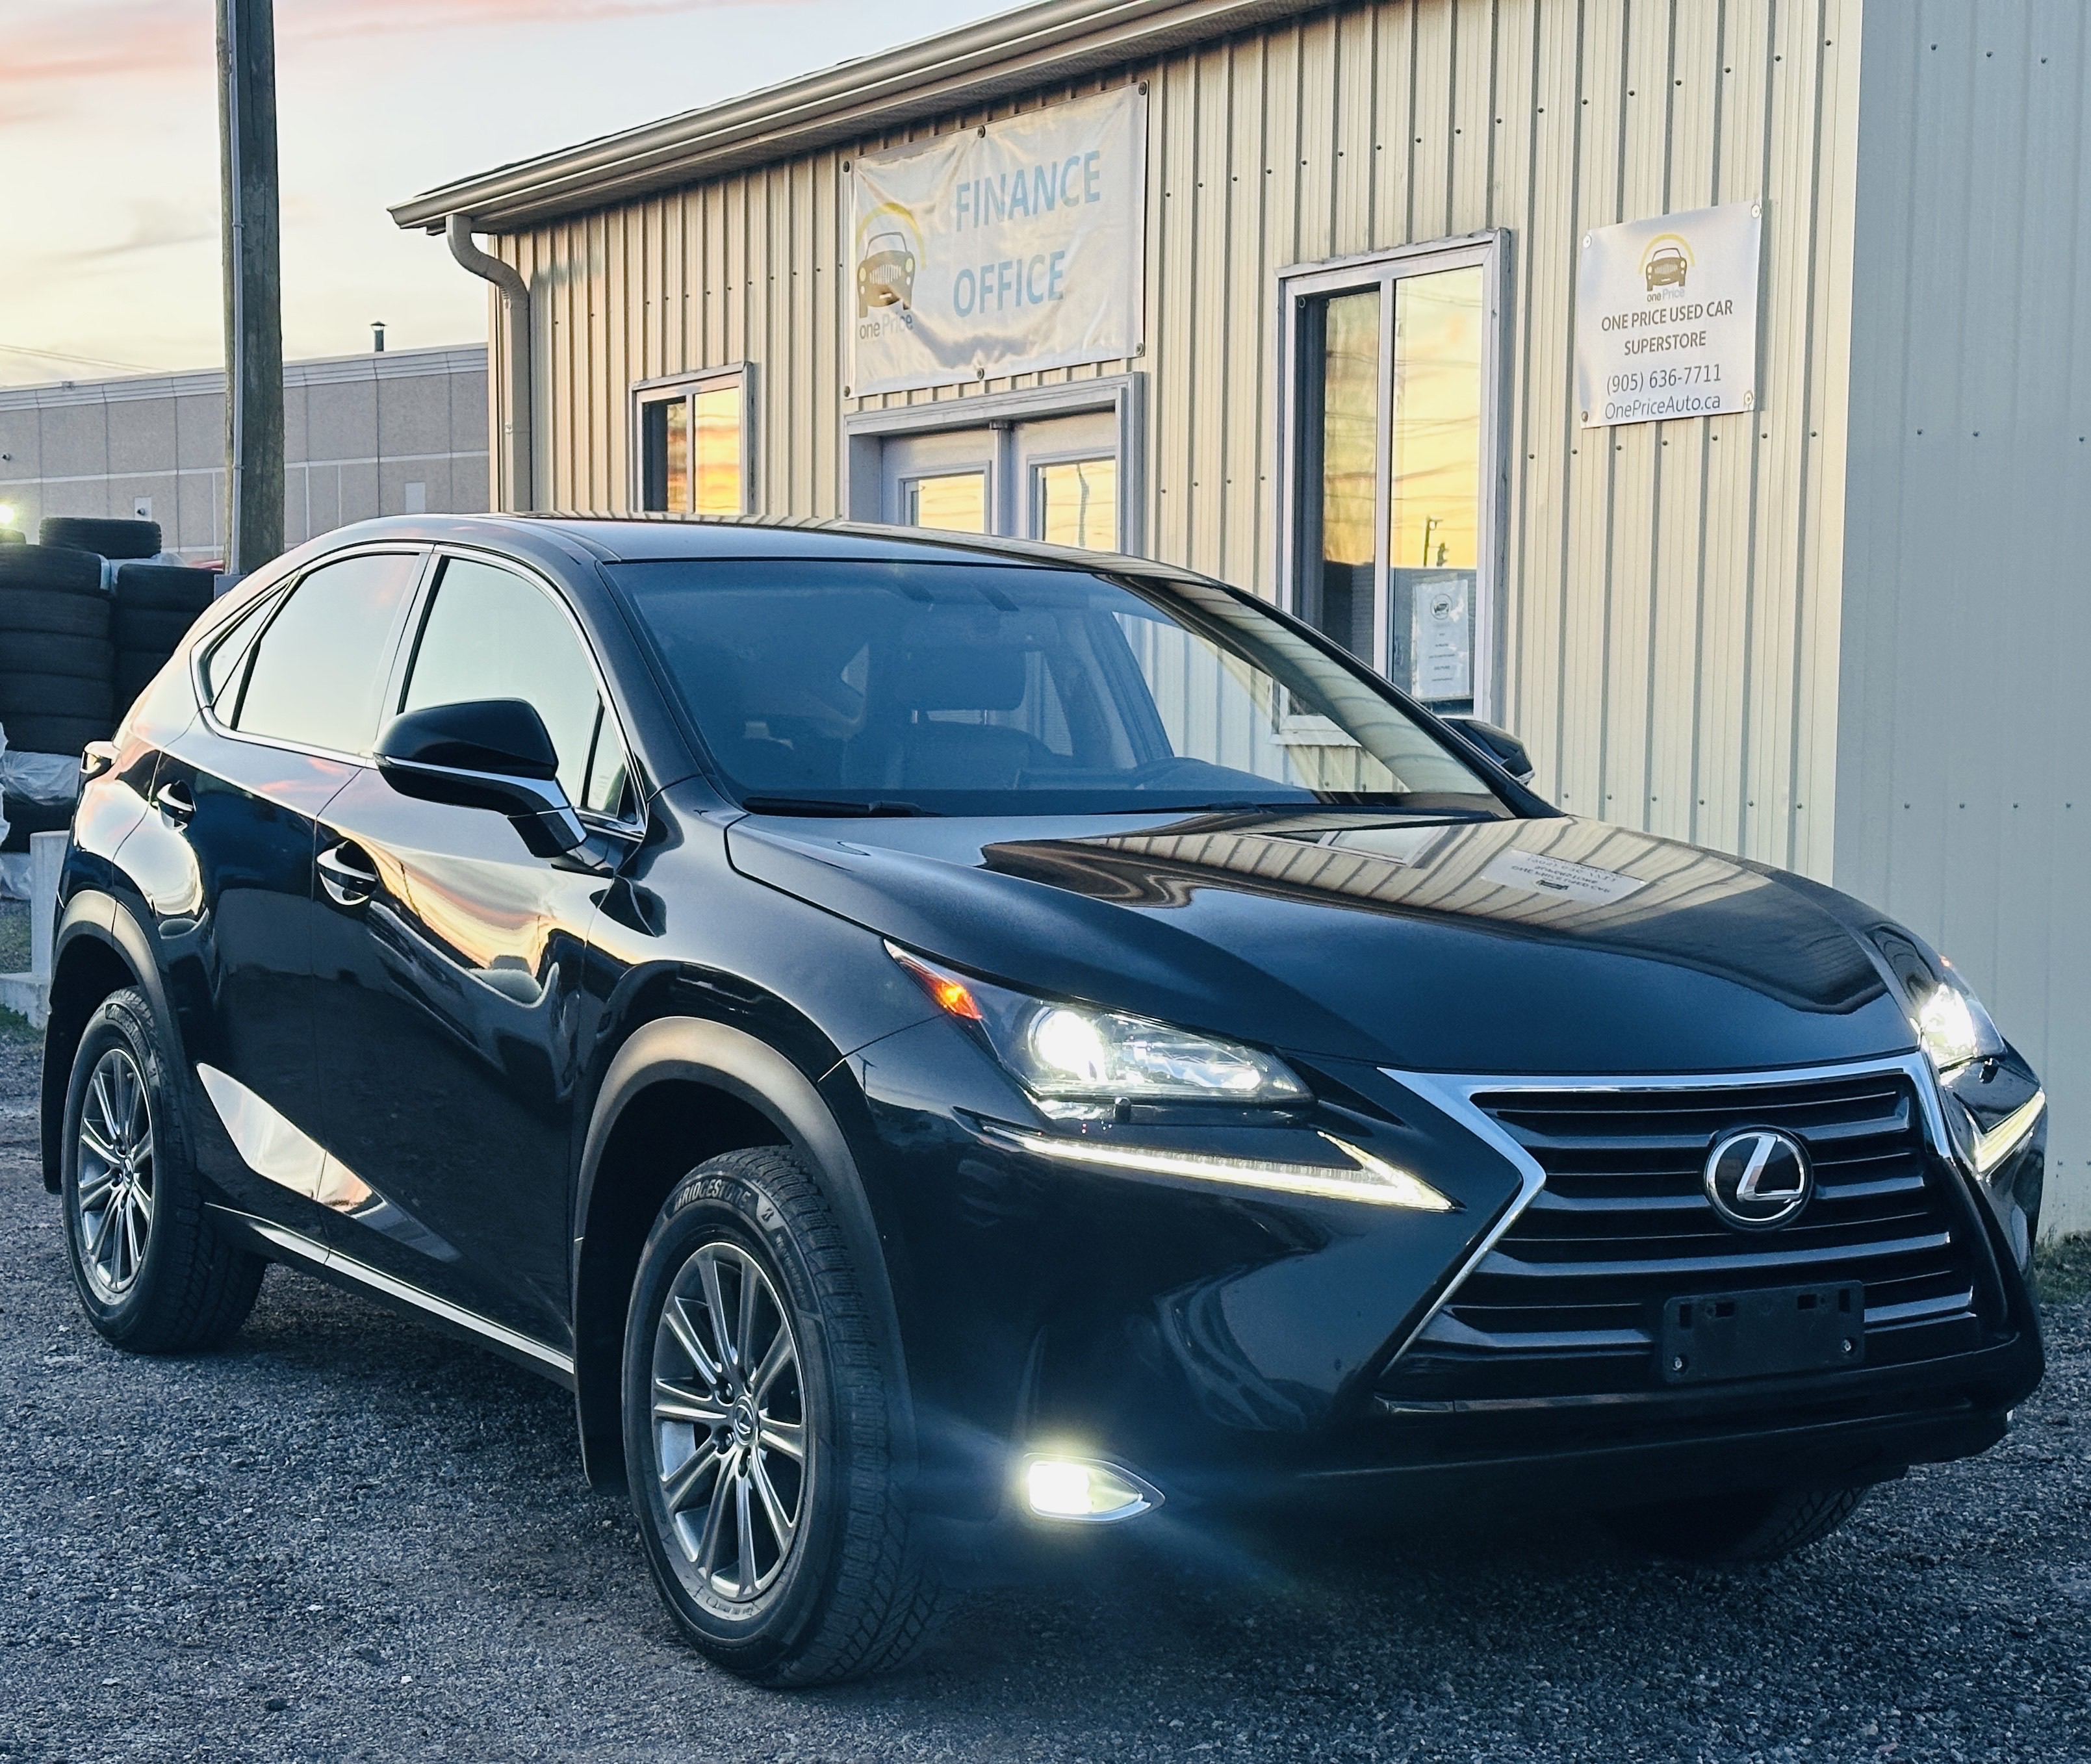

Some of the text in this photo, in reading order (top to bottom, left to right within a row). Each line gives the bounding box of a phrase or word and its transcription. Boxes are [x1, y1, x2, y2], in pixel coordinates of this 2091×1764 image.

[956, 150, 1101, 232] FINANCE
[953, 250, 1066, 318] OFFICE
[859, 322, 880, 340] one
[1601, 300, 1733, 331] ONE PRICE USED CAR
[1624, 331, 1707, 355] SUPERSTORE
[1606, 363, 1721, 396] (905) 636-7711
[1605, 394, 1721, 420] OnePriceAuto.ca
